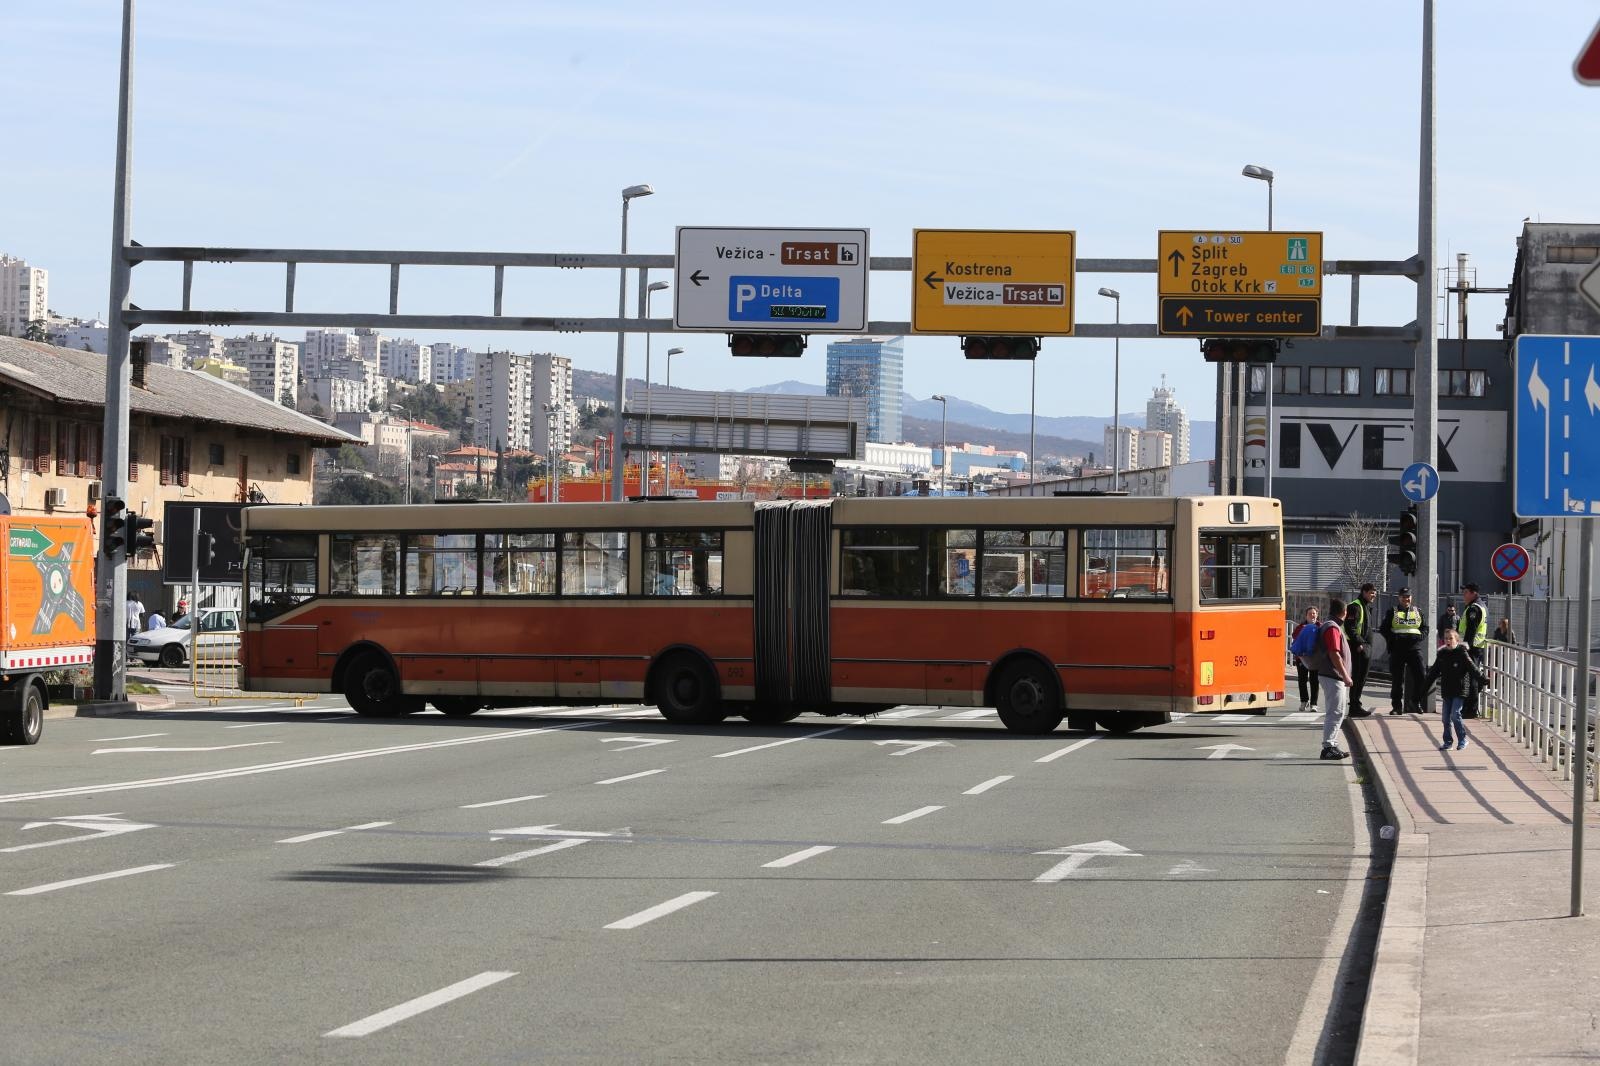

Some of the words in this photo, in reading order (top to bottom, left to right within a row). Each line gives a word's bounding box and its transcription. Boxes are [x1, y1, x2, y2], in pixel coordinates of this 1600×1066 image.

[716, 246, 764, 260] Vežica
[786, 247, 830, 261] Trsat
[1192, 245, 1228, 262] Split
[945, 262, 1012, 276] Kostrena
[1192, 262, 1248, 279] Zagreb
[761, 284, 803, 298] Delta
[1191, 279, 1227, 293] Otok
[1234, 279, 1261, 293] Krk
[736, 284, 757, 313] P
[1005, 287, 1044, 301] Trsat
[1204, 309, 1250, 323] Tower
[1256, 310, 1303, 323] center
[1234, 655, 1248, 667] 593
